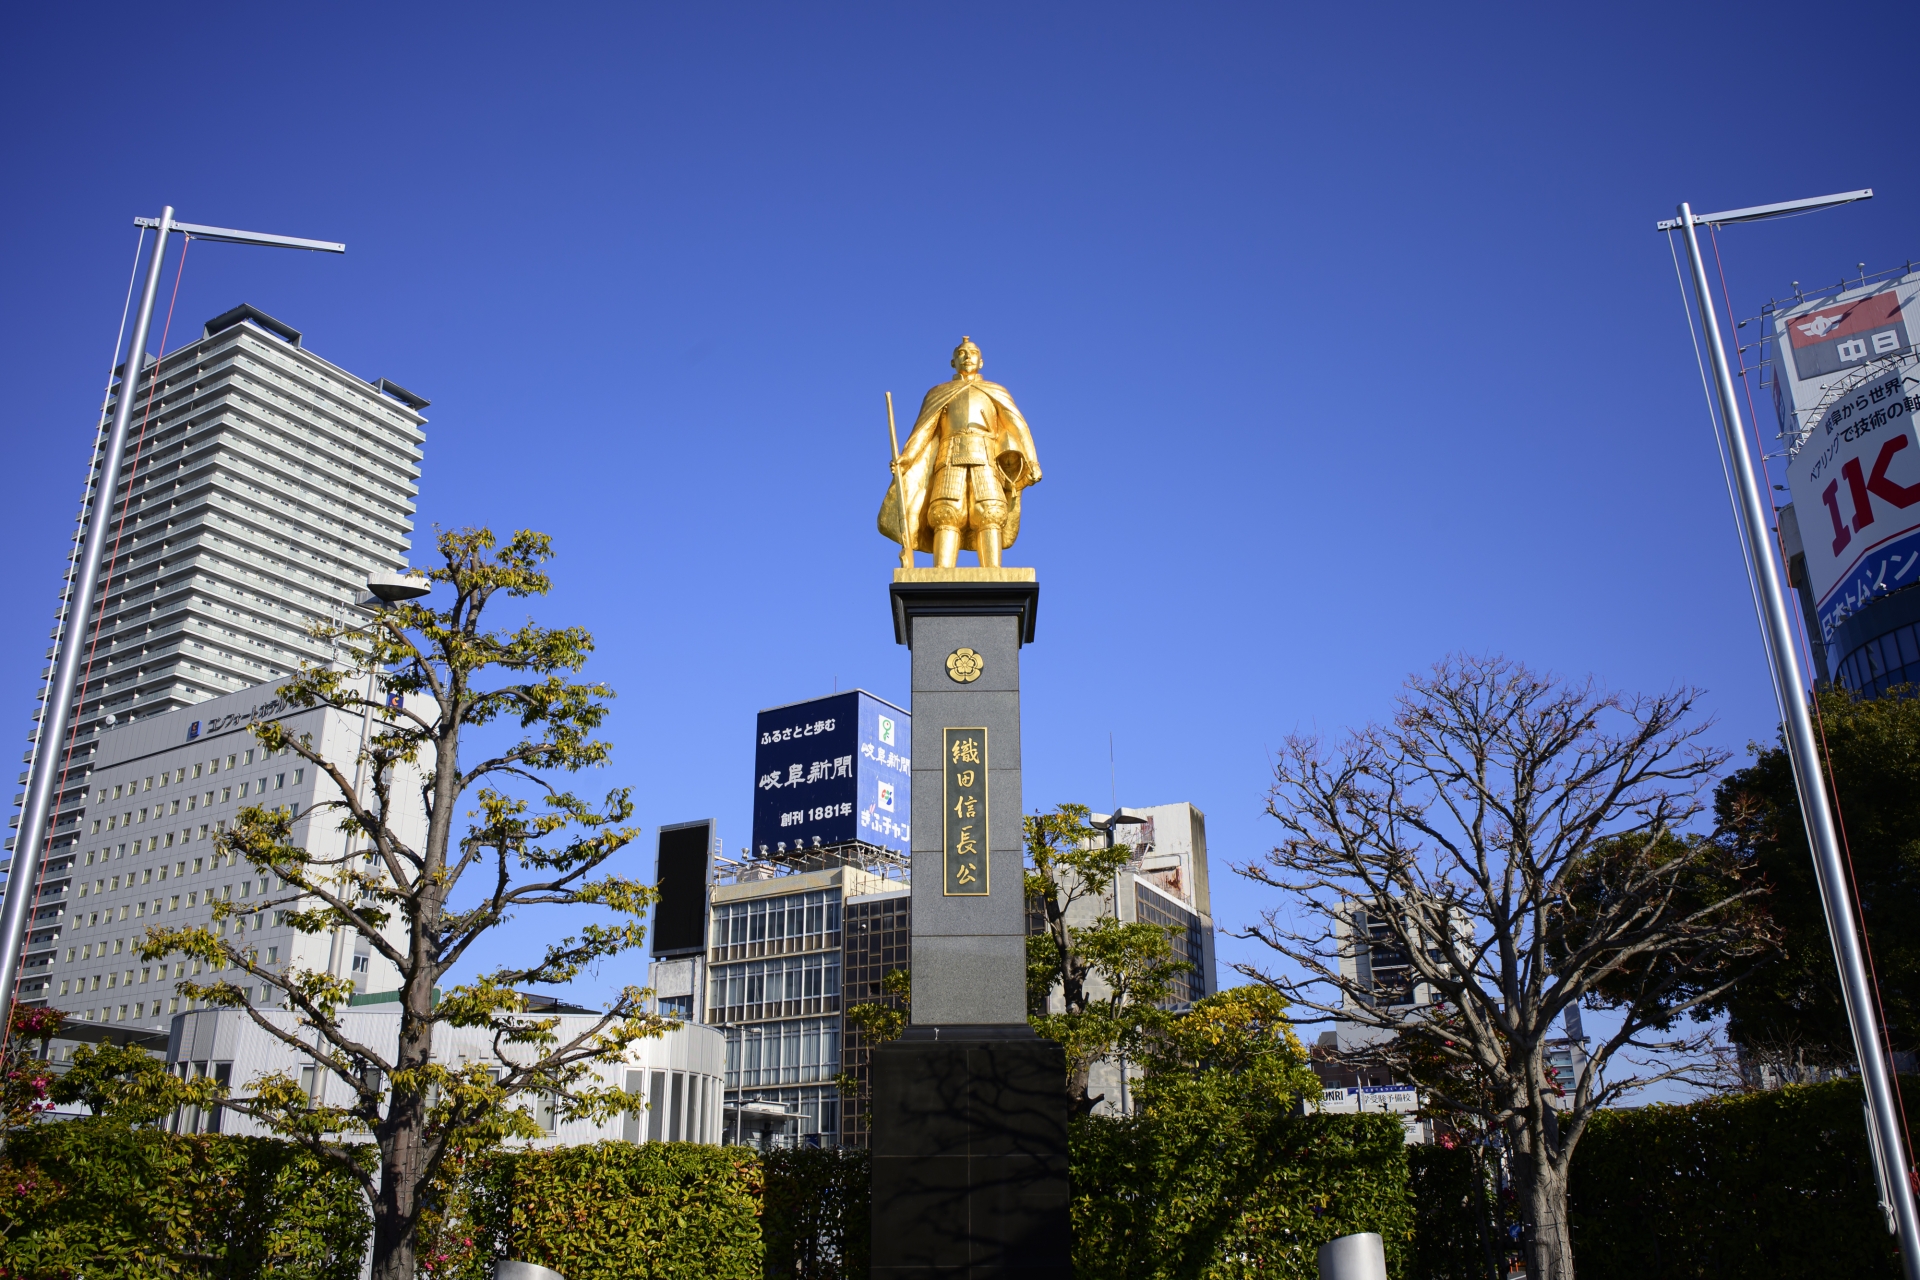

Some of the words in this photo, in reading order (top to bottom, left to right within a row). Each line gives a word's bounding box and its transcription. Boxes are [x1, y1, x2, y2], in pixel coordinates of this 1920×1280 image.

[1837, 329, 1900, 362] 中日
[1825, 376, 1919, 436] 岐阜から世界へ
[1821, 550, 1919, 643] 日本トムソン
[760, 718, 836, 745] ふるさとと歩む
[758, 754, 853, 790] 岐阜新聞
[861, 742, 911, 777] 岐阜新聞
[780, 809, 804, 827] 創刊
[808, 802, 852, 821] 1881年
[861, 803, 910, 842] ぎふチャン
[951, 737, 981, 886] 織田信長公
